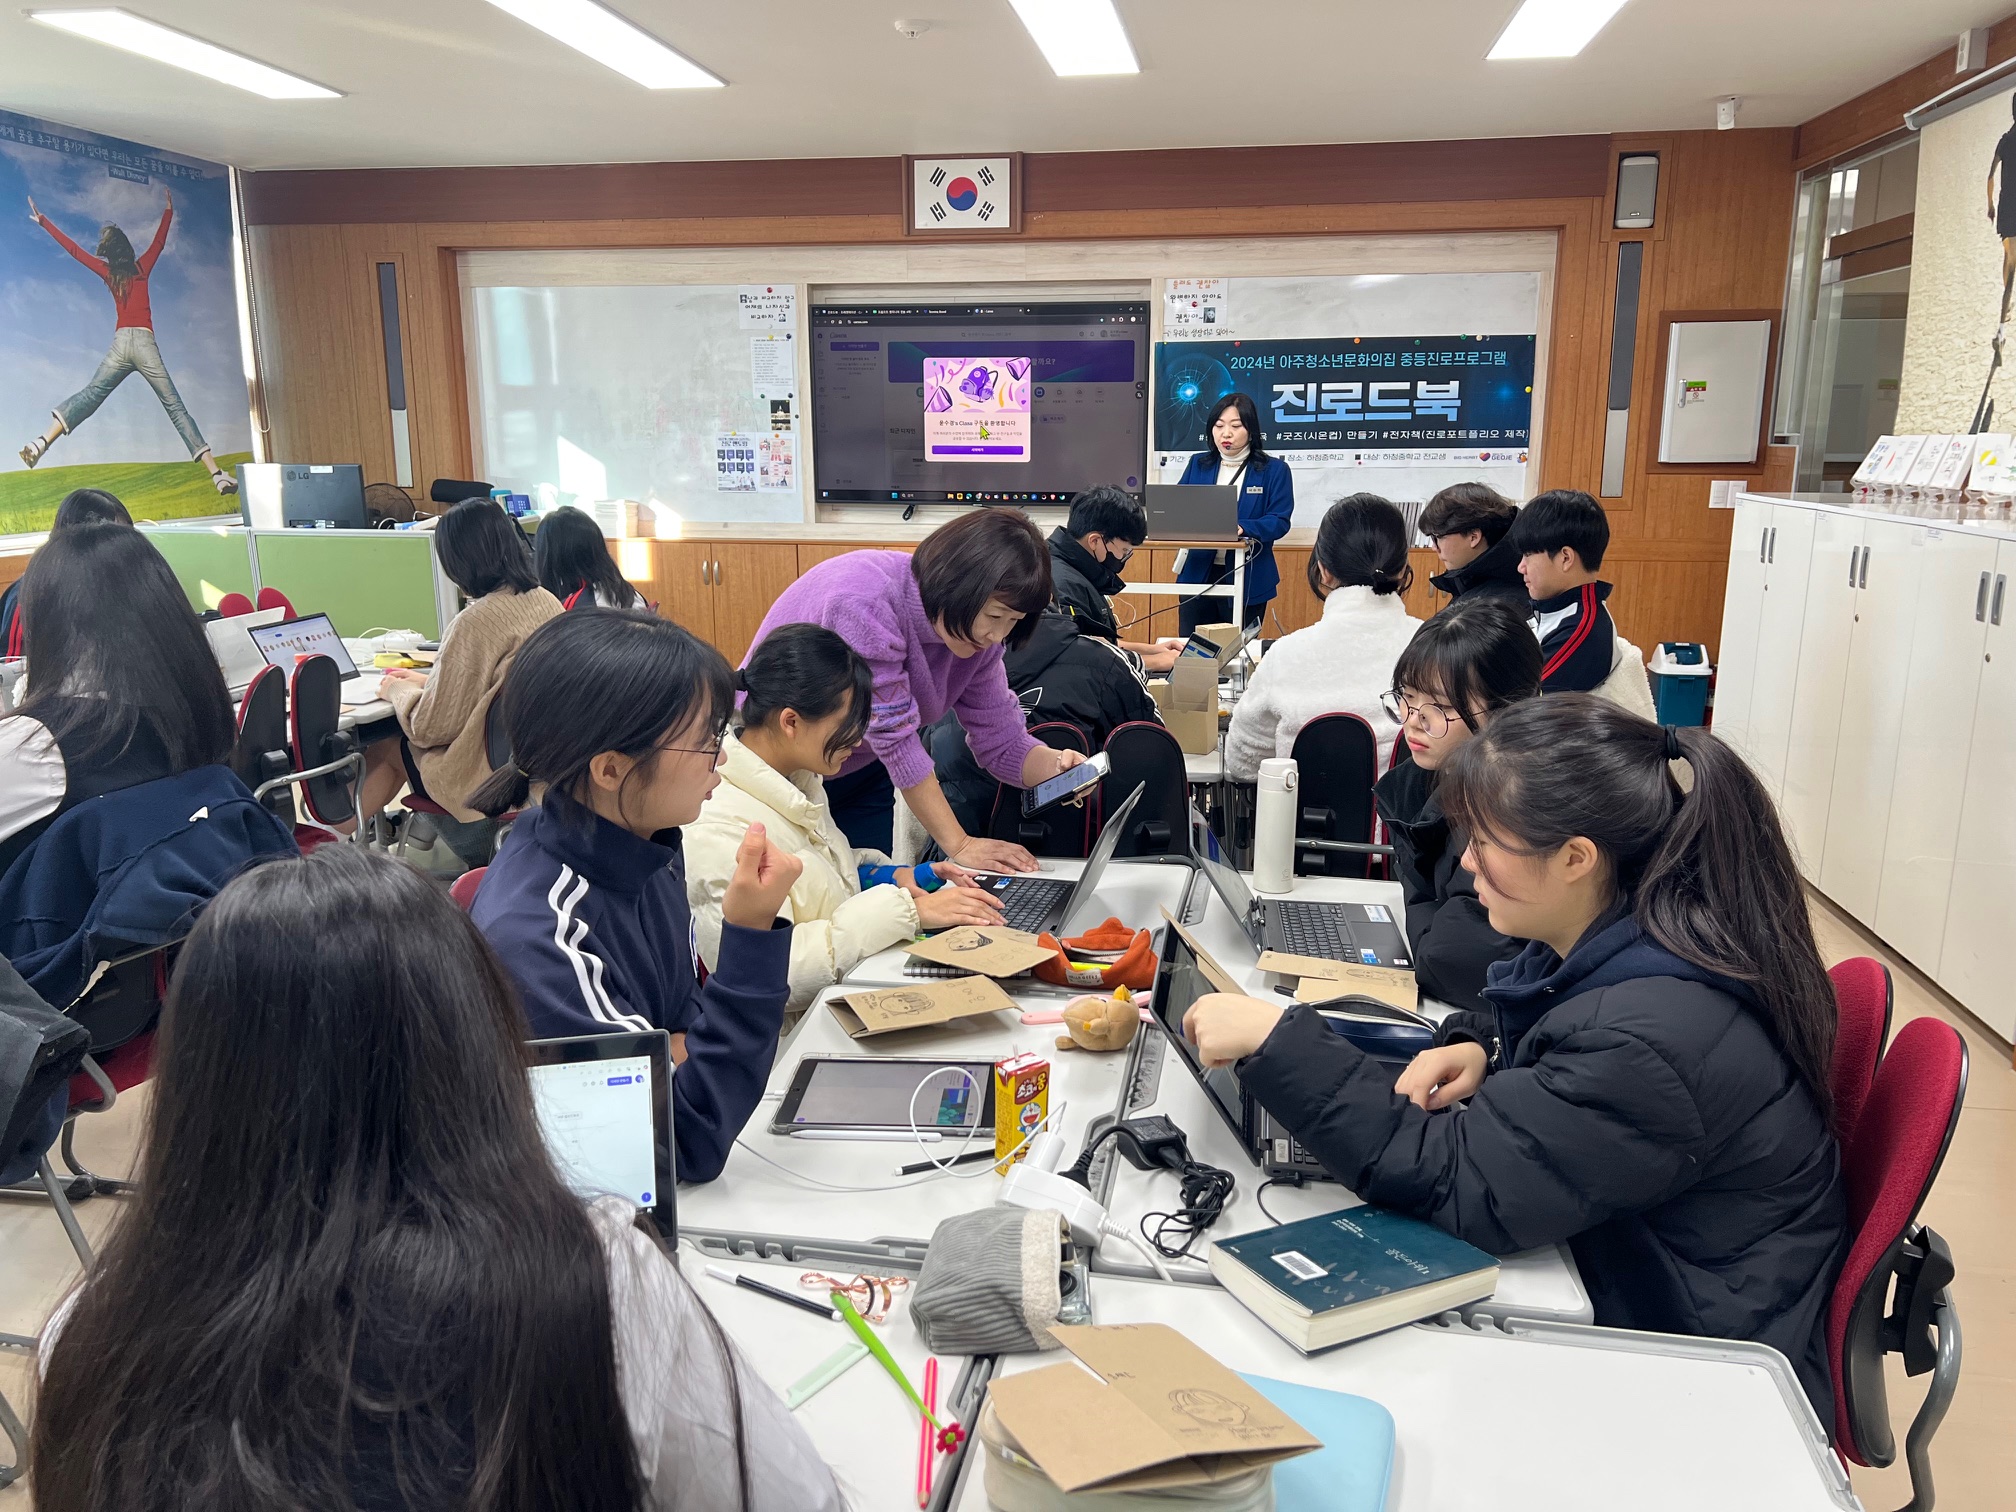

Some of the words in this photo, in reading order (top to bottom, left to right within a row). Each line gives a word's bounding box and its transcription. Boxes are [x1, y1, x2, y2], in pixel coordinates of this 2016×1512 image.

[18, 129, 33, 144] 꿈을
[37, 134, 60, 150] 추구할
[63, 139, 85, 154] 용기가
[87, 145, 109, 160] 있다면
[111, 151, 132, 166] 우리는
[134, 156, 148, 170] 모든
[150, 160, 163, 174] 꿈을
[1173, 328, 1189, 337] 우리는
[1230, 355, 1275, 370] 2024년
[1280, 353, 1396, 369] 아주청소년문화의집
[1400, 351, 1507, 367] 중등진로프로그램
[1270, 380, 1462, 423] 진로드북
[1276, 431, 1342, 441] #굿즈(시온컵)
[1347, 430, 1378, 440] 만들기
[1382, 429, 1500, 440] #전자책(진로포트폴리오
